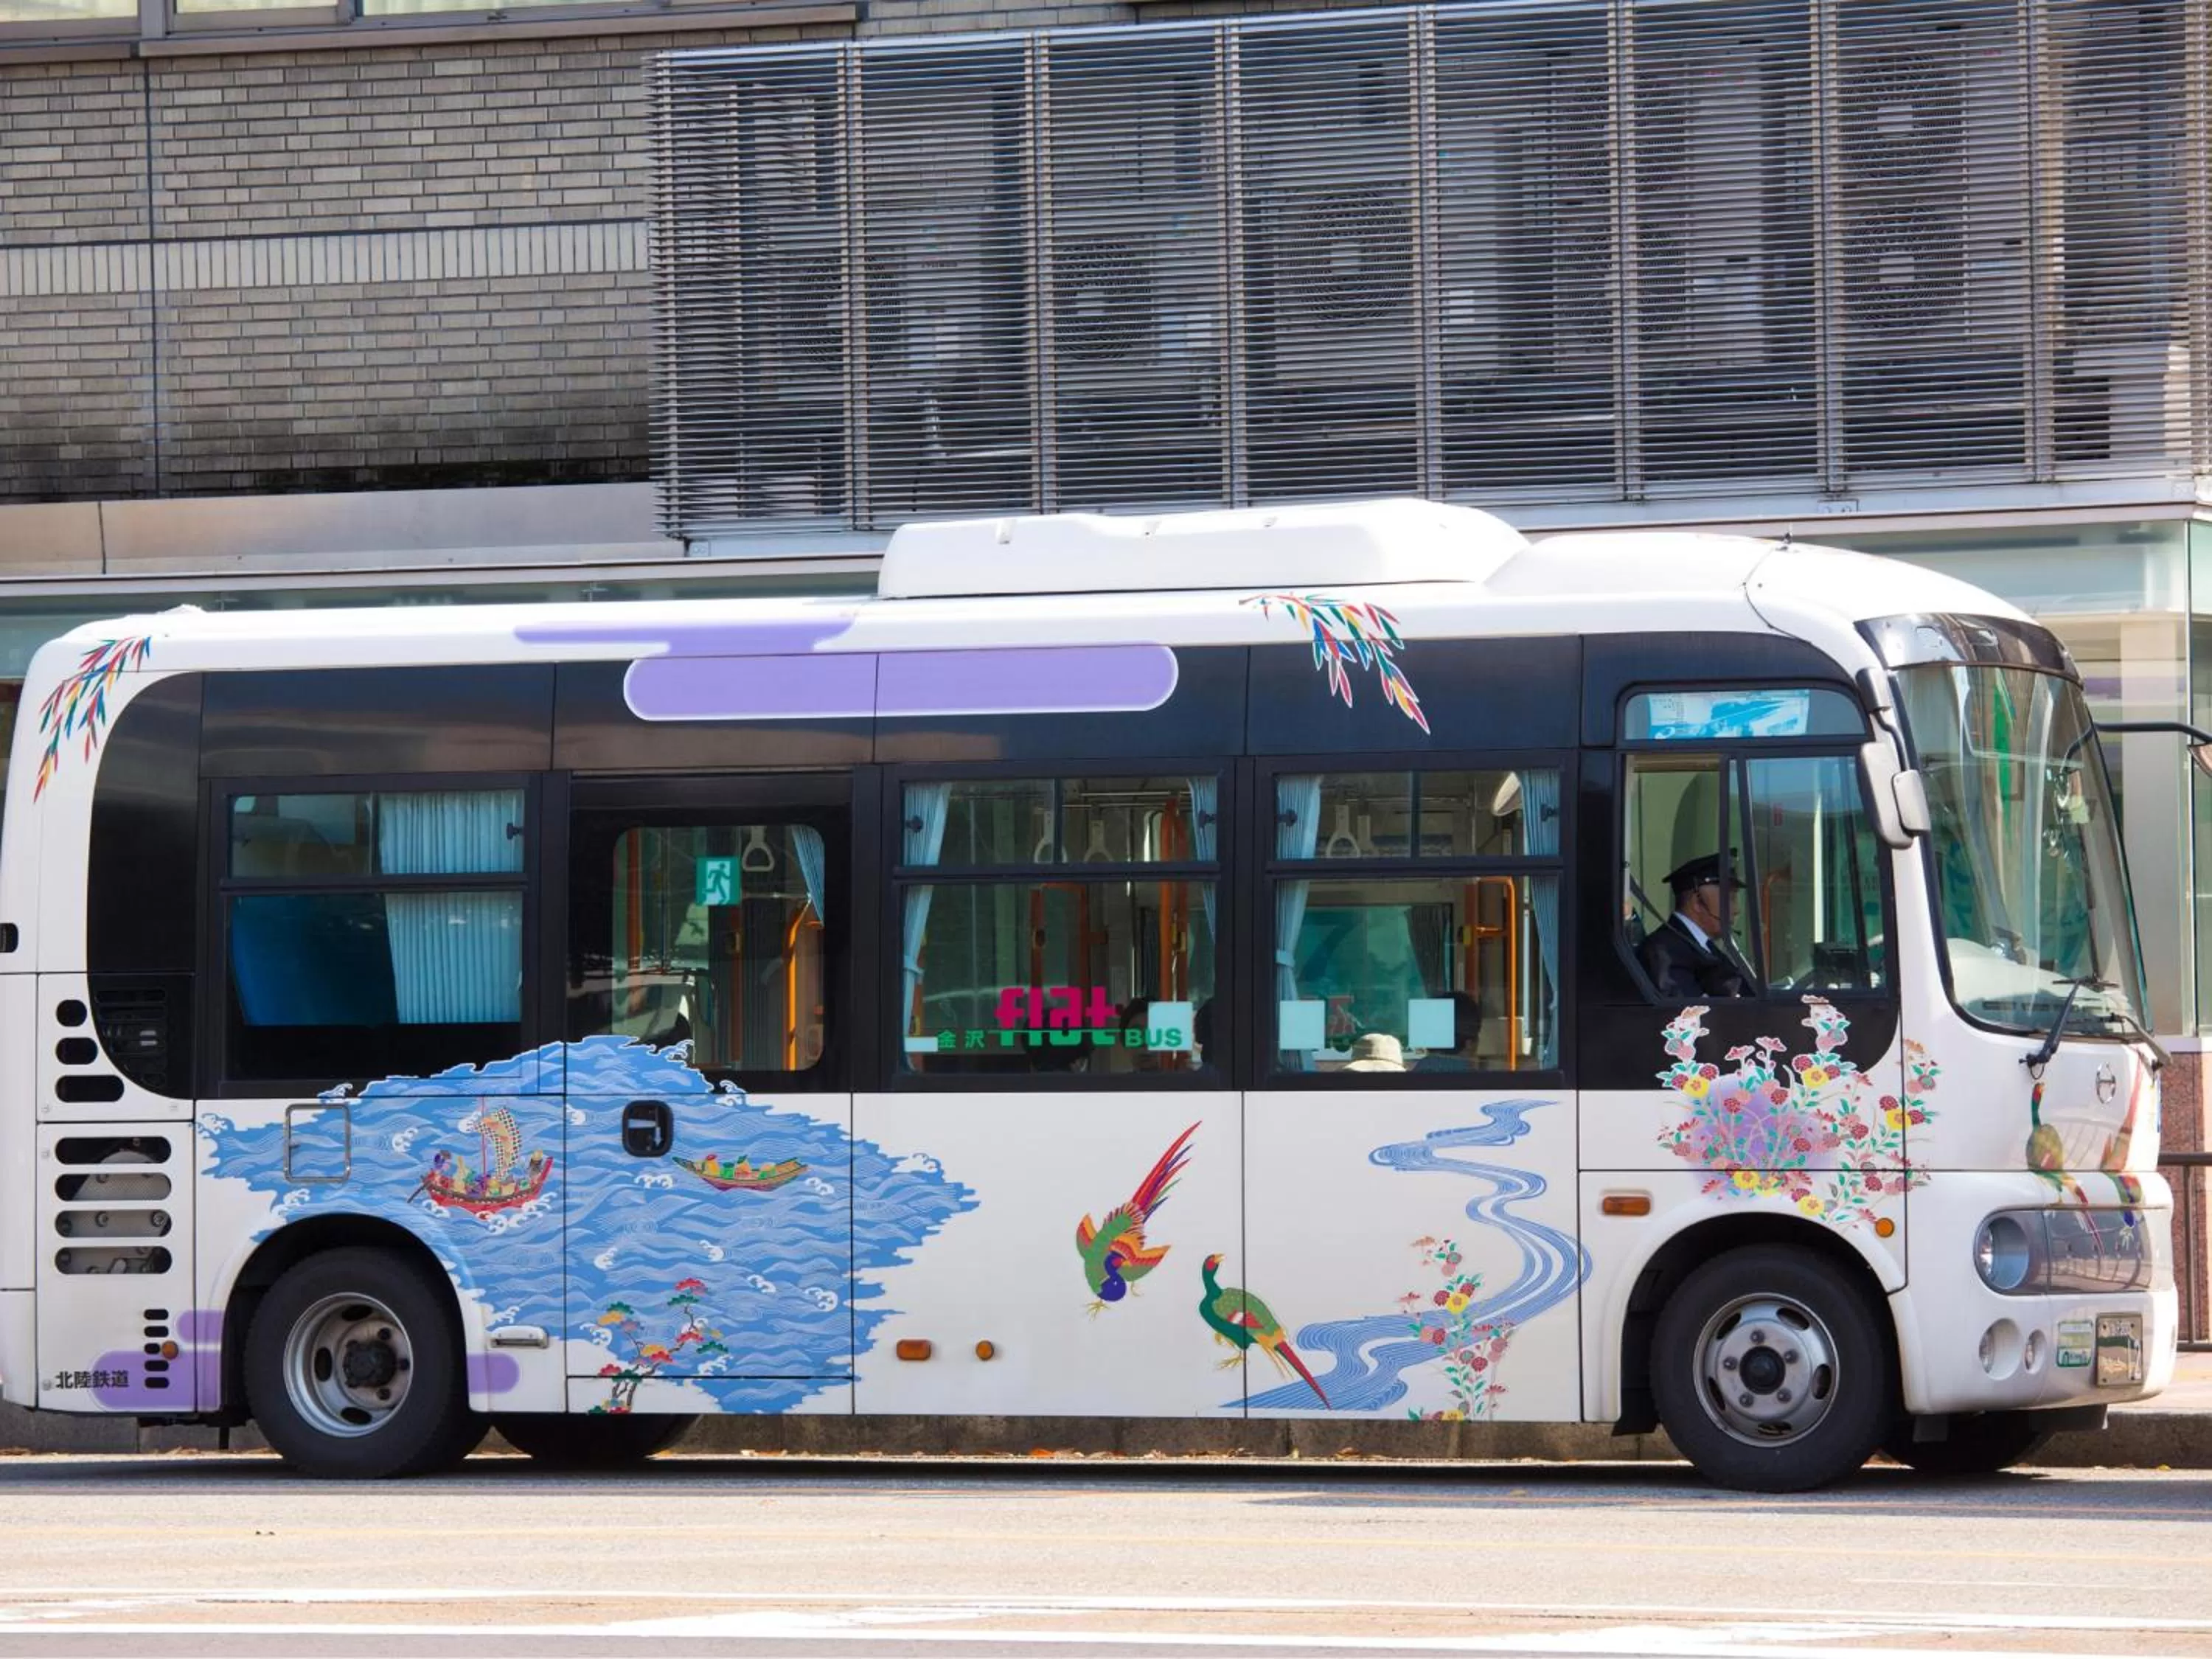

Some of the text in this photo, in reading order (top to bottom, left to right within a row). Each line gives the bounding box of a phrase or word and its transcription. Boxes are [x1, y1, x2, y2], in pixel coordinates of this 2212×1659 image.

[936, 986, 1183, 1048] 金沢 flat BUS
[55, 1370, 129, 1389] 北陸鉄道
